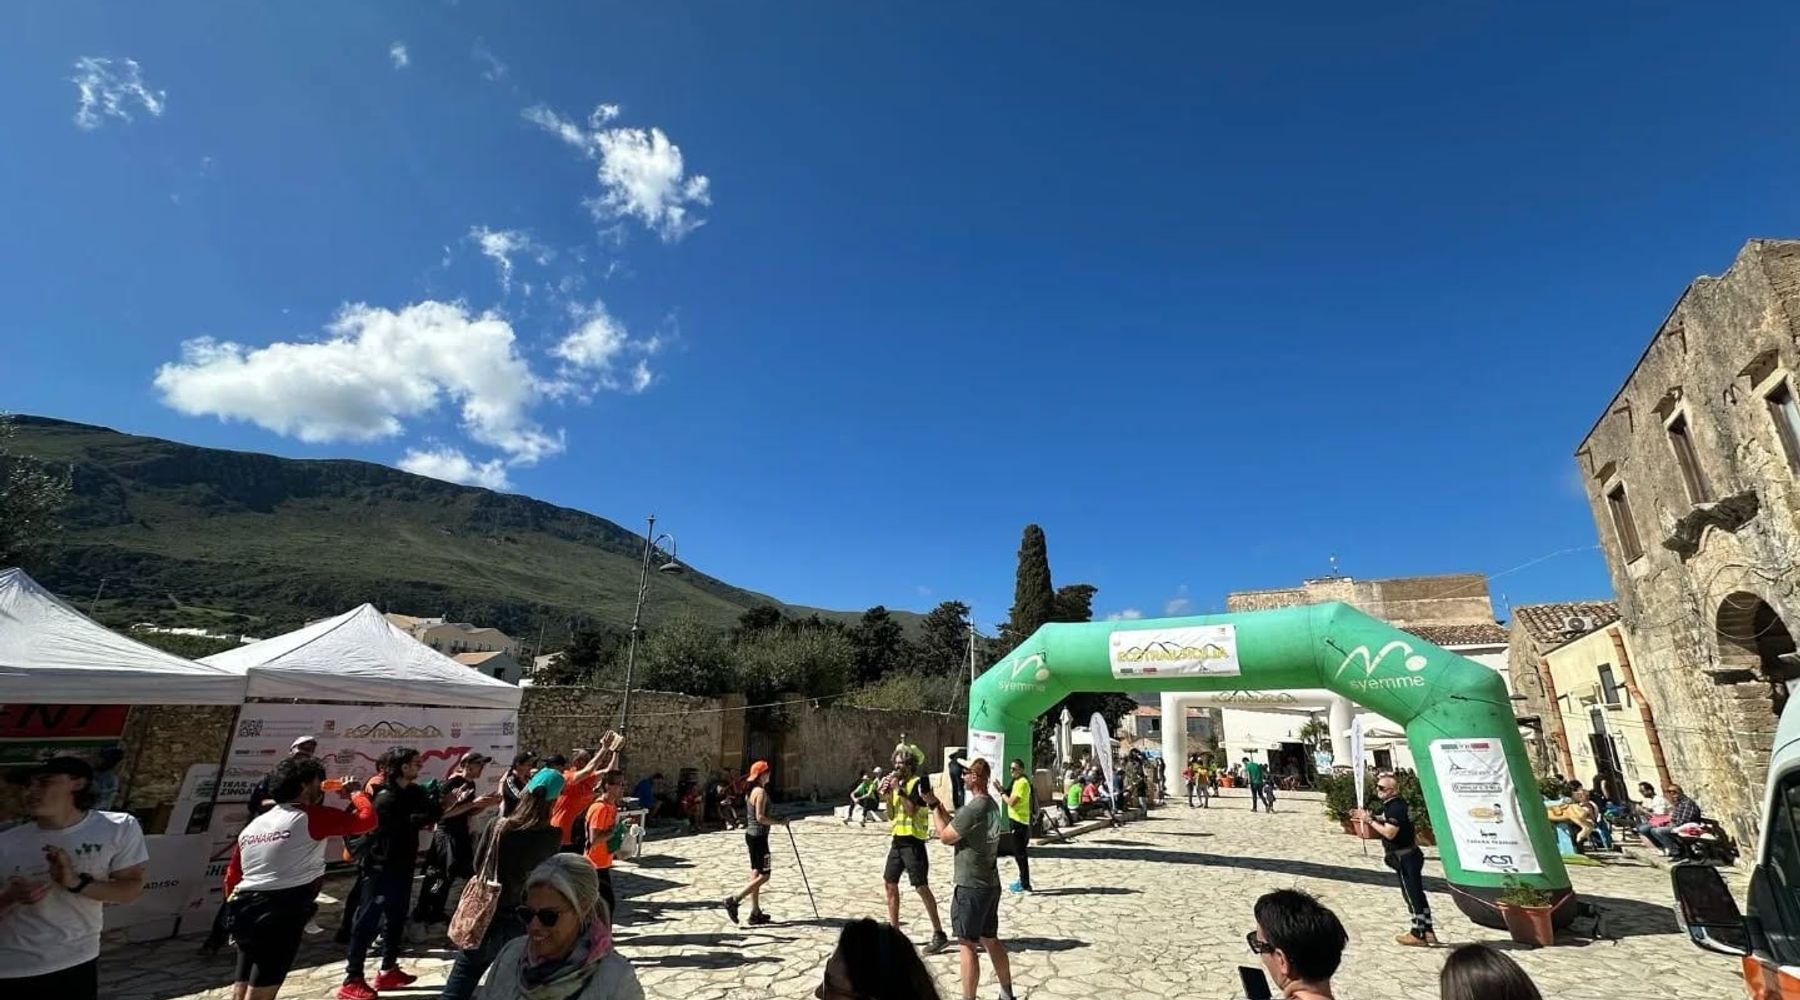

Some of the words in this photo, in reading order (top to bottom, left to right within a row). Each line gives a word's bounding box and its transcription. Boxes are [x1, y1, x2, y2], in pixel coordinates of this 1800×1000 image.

[998, 681, 1046, 692] syemme
[1350, 675, 1425, 693] syemme
[220, 788, 253, 796] ZINGA
[1482, 854, 1513, 865] ACSI
